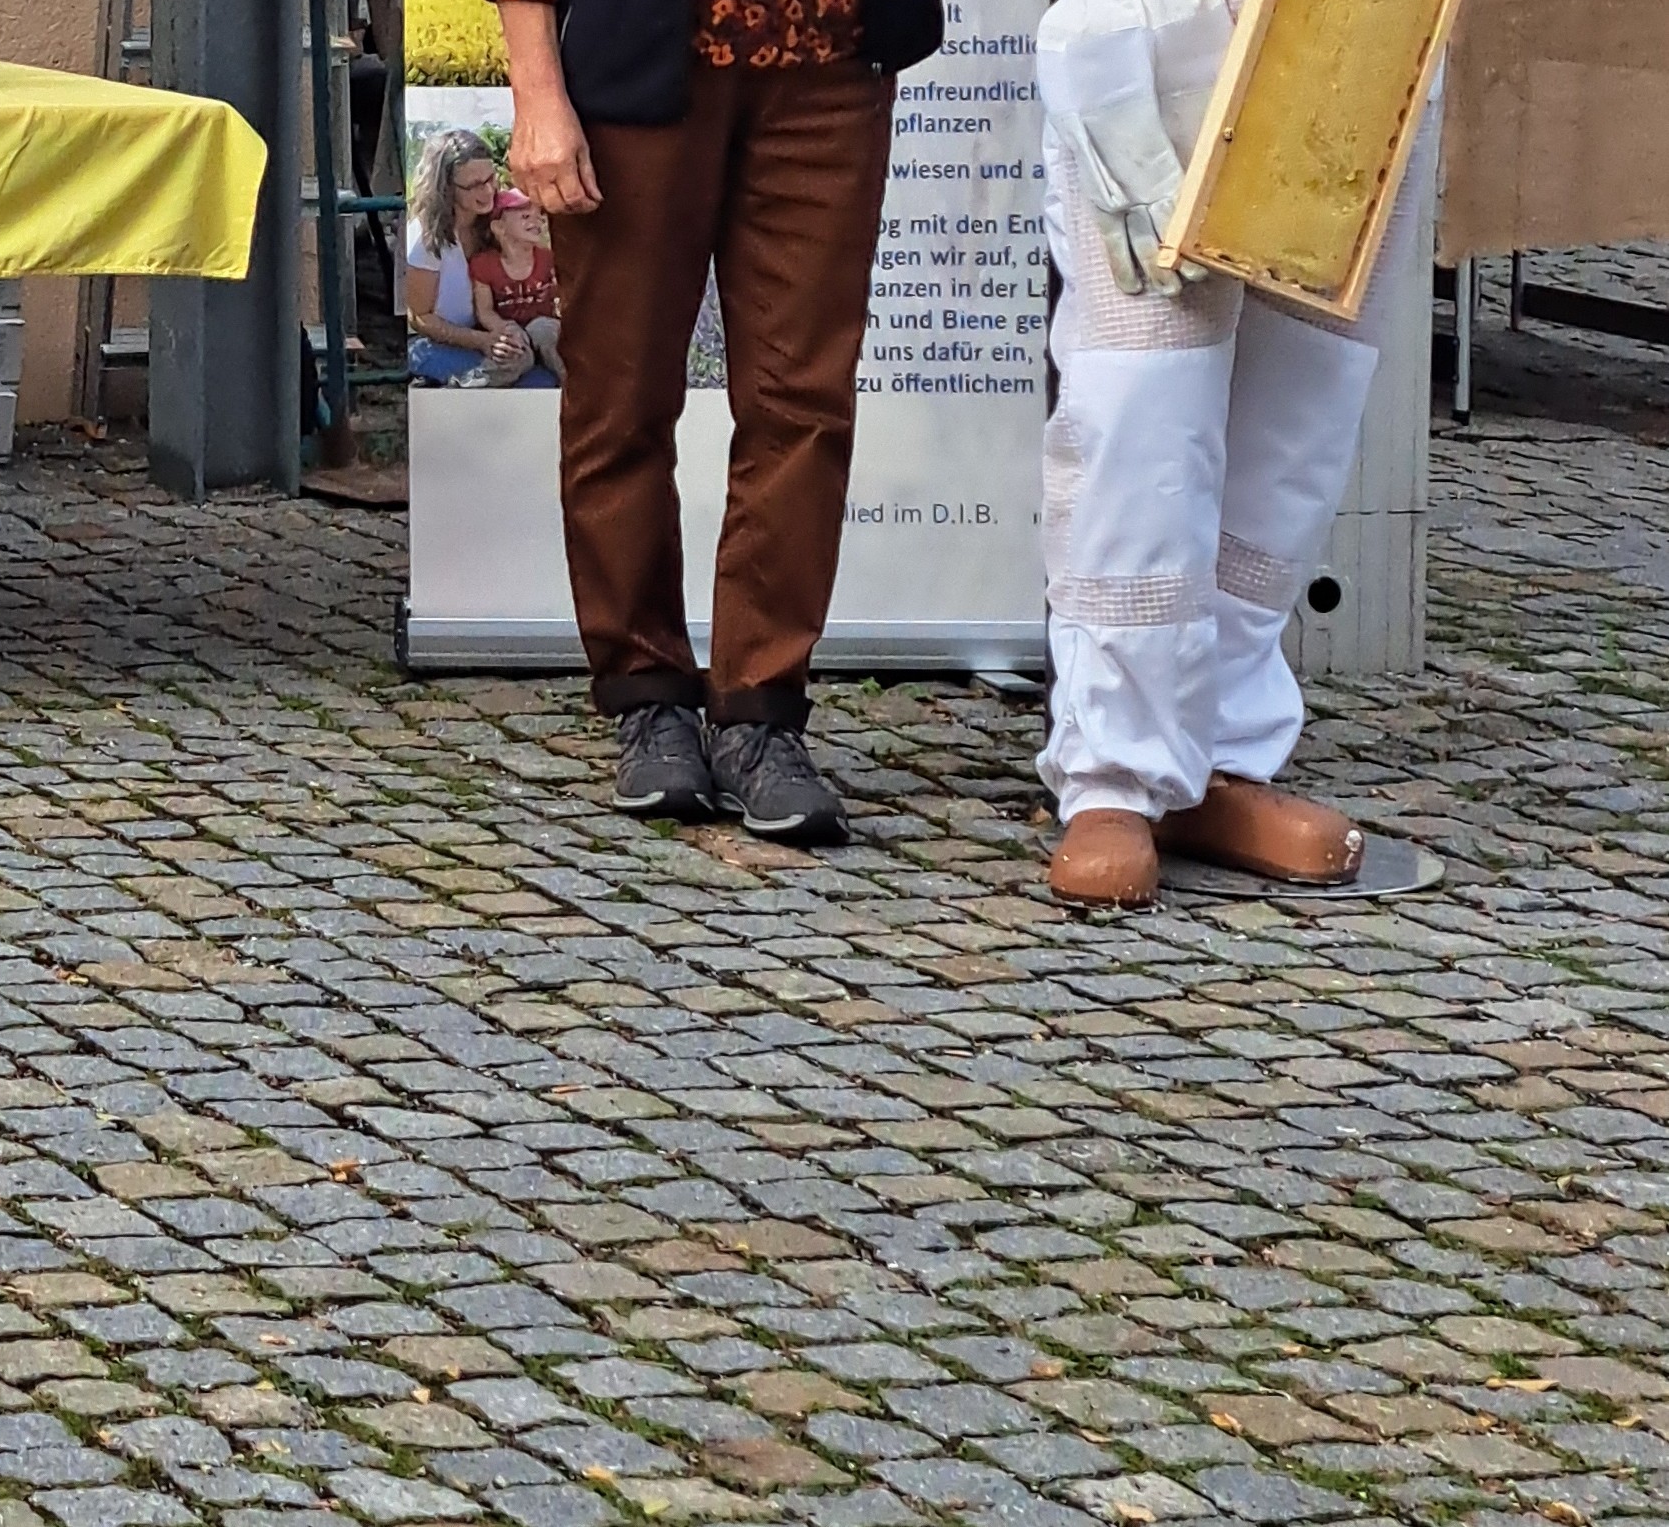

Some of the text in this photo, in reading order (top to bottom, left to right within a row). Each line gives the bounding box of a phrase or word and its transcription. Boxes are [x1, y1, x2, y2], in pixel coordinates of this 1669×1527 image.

[979, 158, 1023, 180] und
[910, 213, 998, 235] mit den
[929, 245, 1017, 269] wir auf,
[951, 277, 1019, 299] in der
[889, 309, 1007, 330] und Biene
[873, 341, 1034, 365] uns dafür ein,
[856, 372, 1034, 394] zu öffentlichem
[894, 503, 998, 525] im D.I.B.
